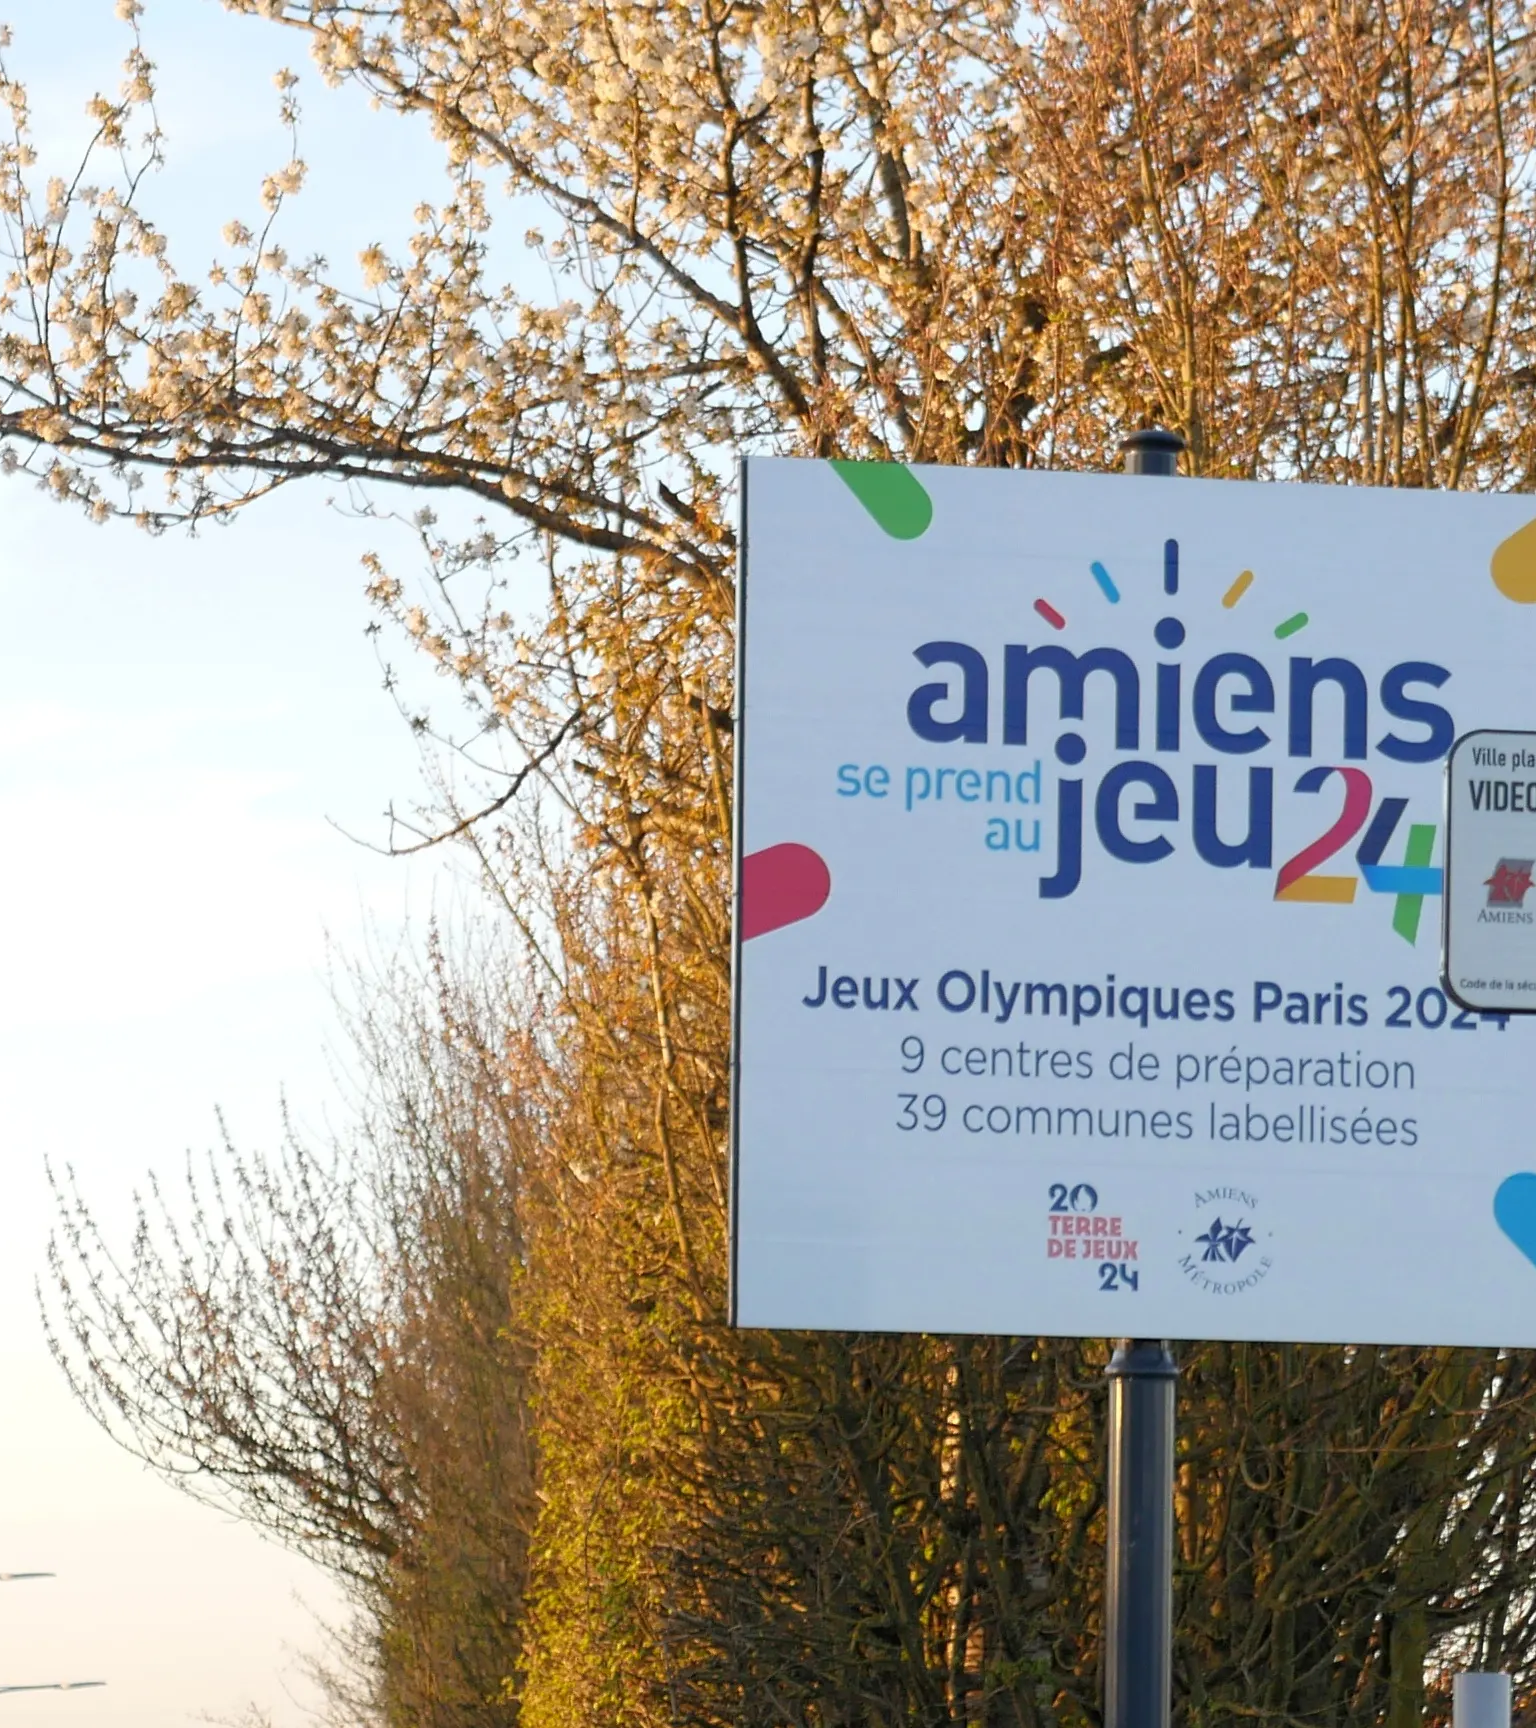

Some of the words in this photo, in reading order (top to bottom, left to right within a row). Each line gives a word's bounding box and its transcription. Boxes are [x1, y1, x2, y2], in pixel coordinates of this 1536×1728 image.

[907, 616, 1456, 763] amiens
[1472, 747, 1507, 767] Ville
[836, 763, 891, 798] se
[906, 760, 1042, 811] prend
[984, 817, 1041, 852] au
[1477, 909, 1534, 924] AMIENS
[802, 965, 920, 1011] Jeux
[937, 969, 1236, 1029] Olympiques
[1253, 980, 1369, 1027] Paris
[1459, 978, 1488, 990] Code
[1488, 979, 1503, 990] de
[1505, 979, 1515, 991] la
[900, 1035, 925, 1074] 9
[940, 1041, 1094, 1080] centres
[1109, 1041, 1160, 1082] de
[1176, 1045, 1415, 1092] préparation
[896, 1093, 947, 1132] 39
[962, 1104, 1193, 1140] communes
[1210, 1101, 1418, 1147] labellisées
[1194, 1187, 1259, 1209] AMIENS
[1048, 1215, 1122, 1238] TERRE
[1047, 1238, 1077, 1259] DE
[1082, 1239, 1138, 1261] JEUX
[1098, 1262, 1139, 1292] 24
[1177, 1253, 1273, 1296] MÉTROPOLE
